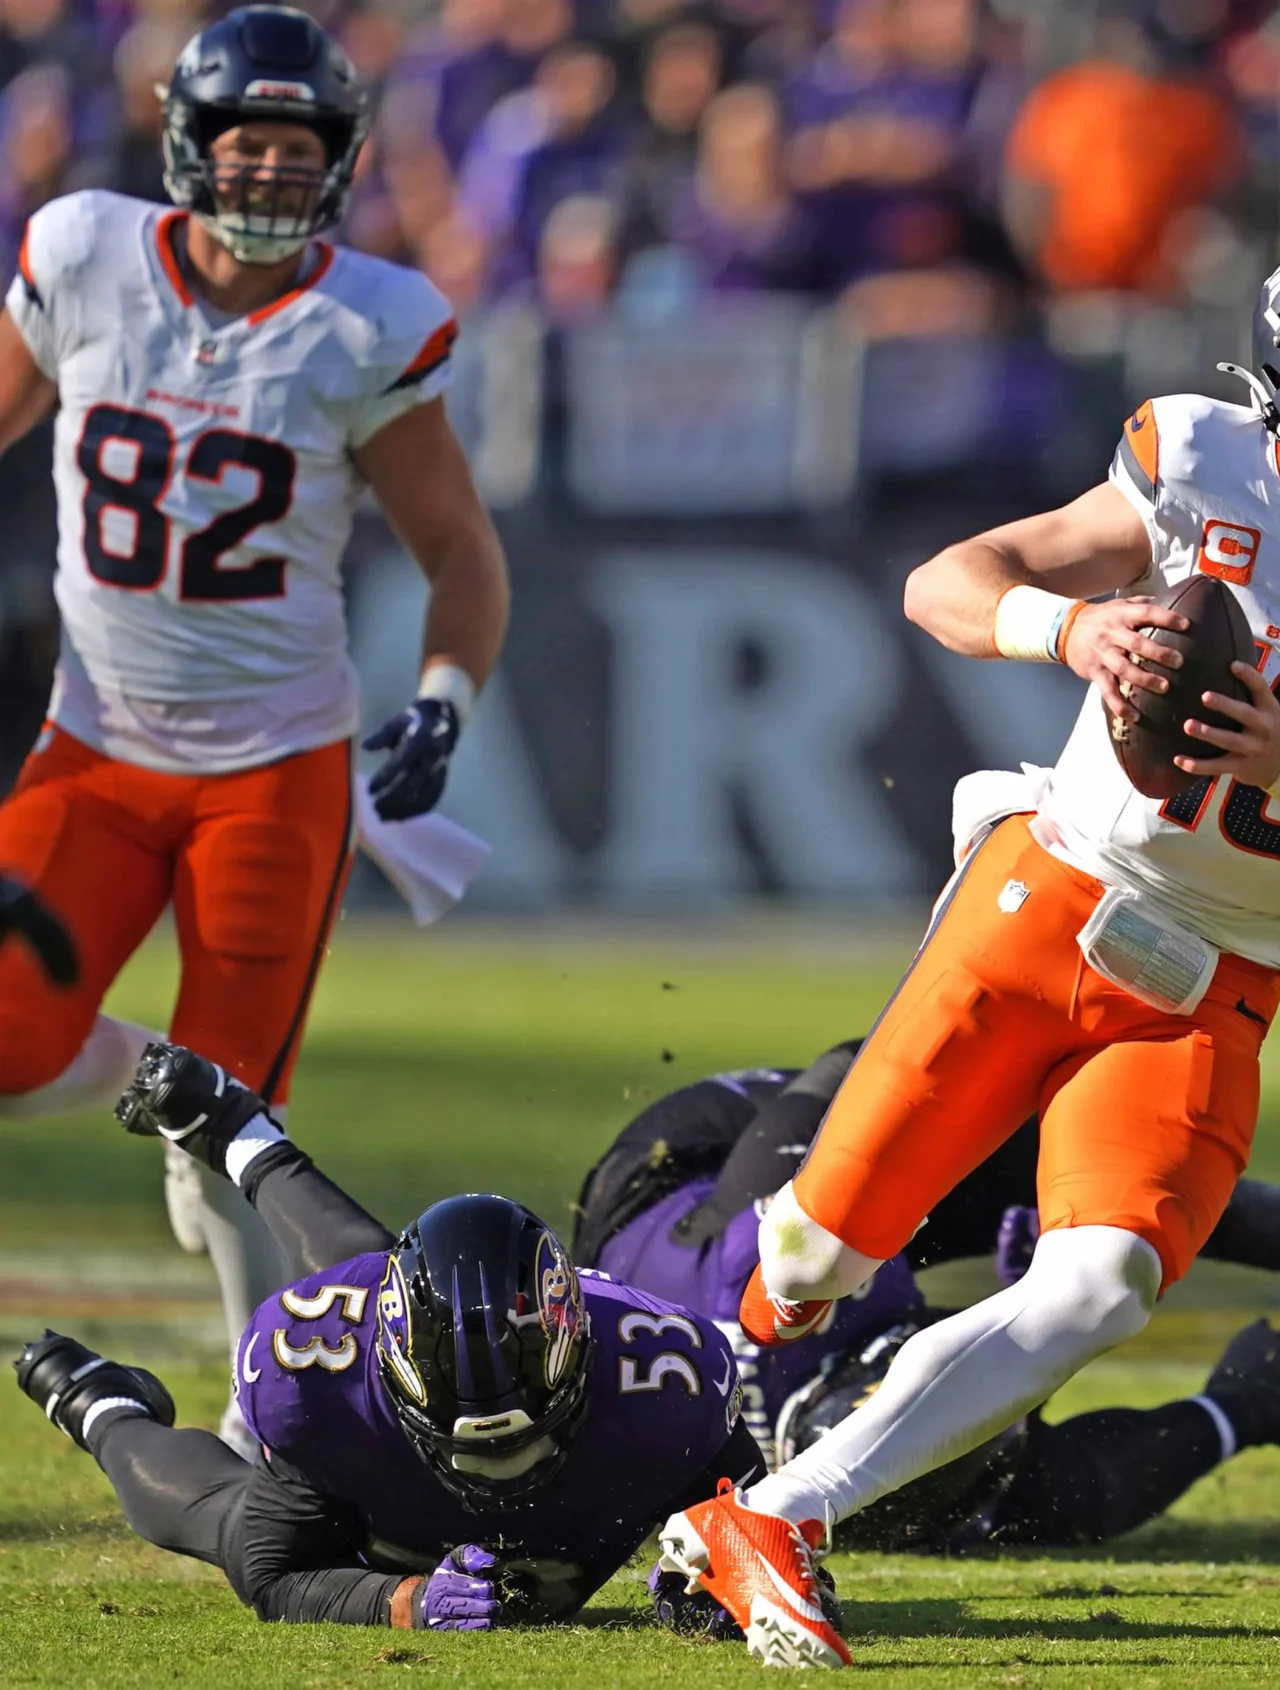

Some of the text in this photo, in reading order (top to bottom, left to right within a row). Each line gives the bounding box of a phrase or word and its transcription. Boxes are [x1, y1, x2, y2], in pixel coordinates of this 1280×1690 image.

[76, 401, 297, 605] 82
[1204, 525, 1256, 569] C
[273, 1284, 370, 1373] 53
[617, 1310, 703, 1397] 53
